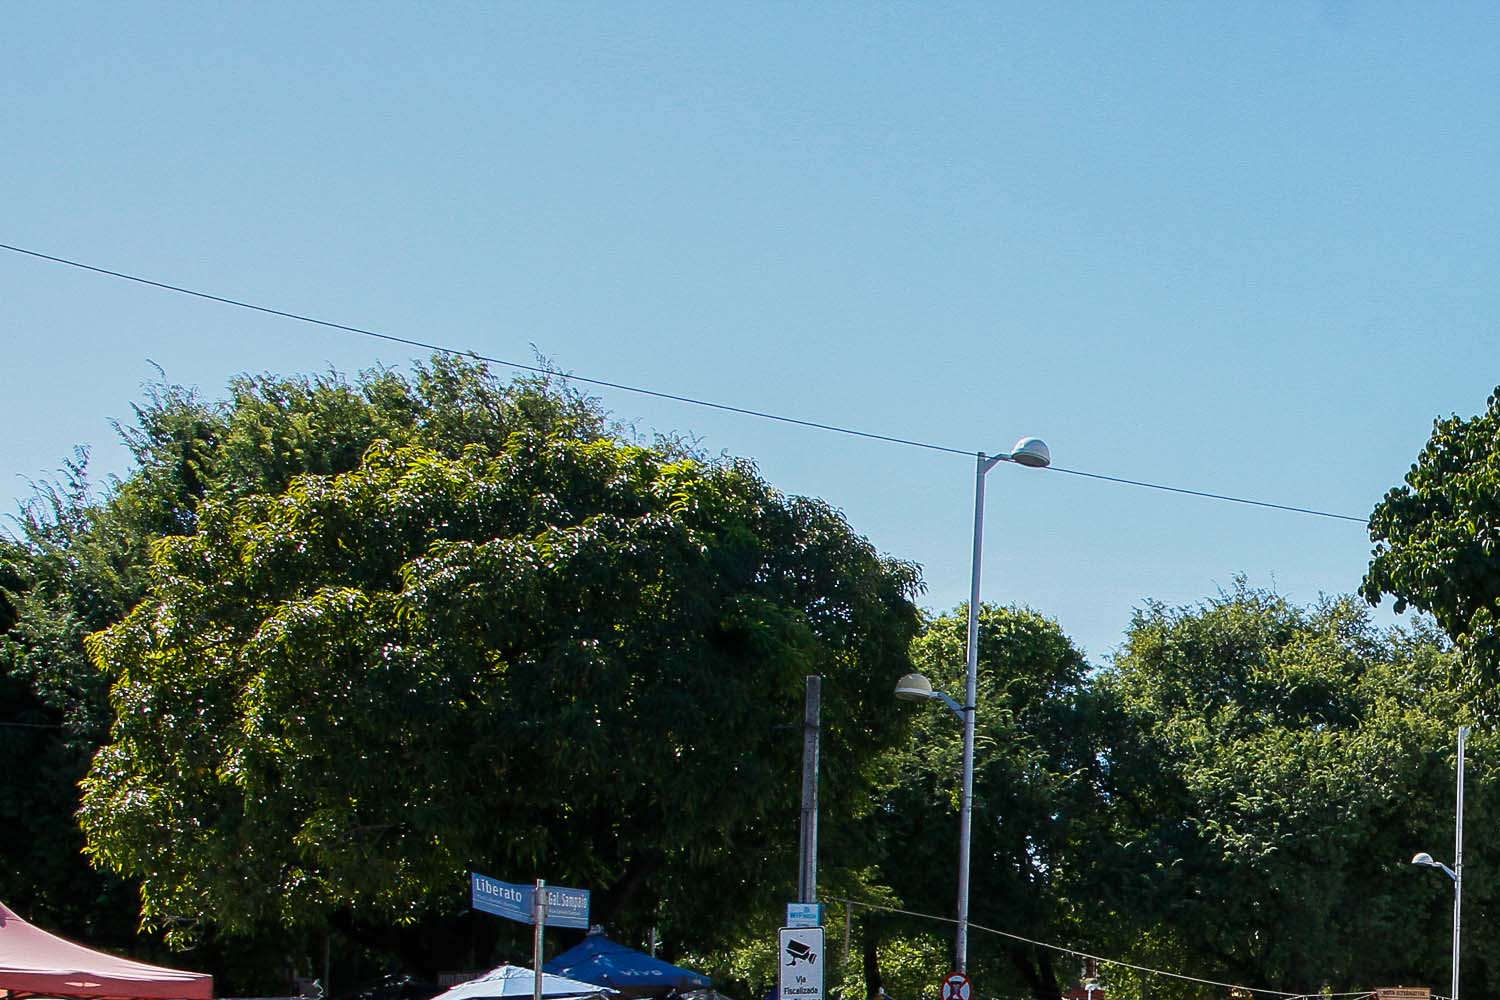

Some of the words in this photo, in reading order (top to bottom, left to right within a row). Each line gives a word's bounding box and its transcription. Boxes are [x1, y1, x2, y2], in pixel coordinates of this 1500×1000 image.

[475, 878, 522, 903] Liberato
[562, 892, 587, 911] Sampaio
[784, 987, 818, 995] Fiscalizada
